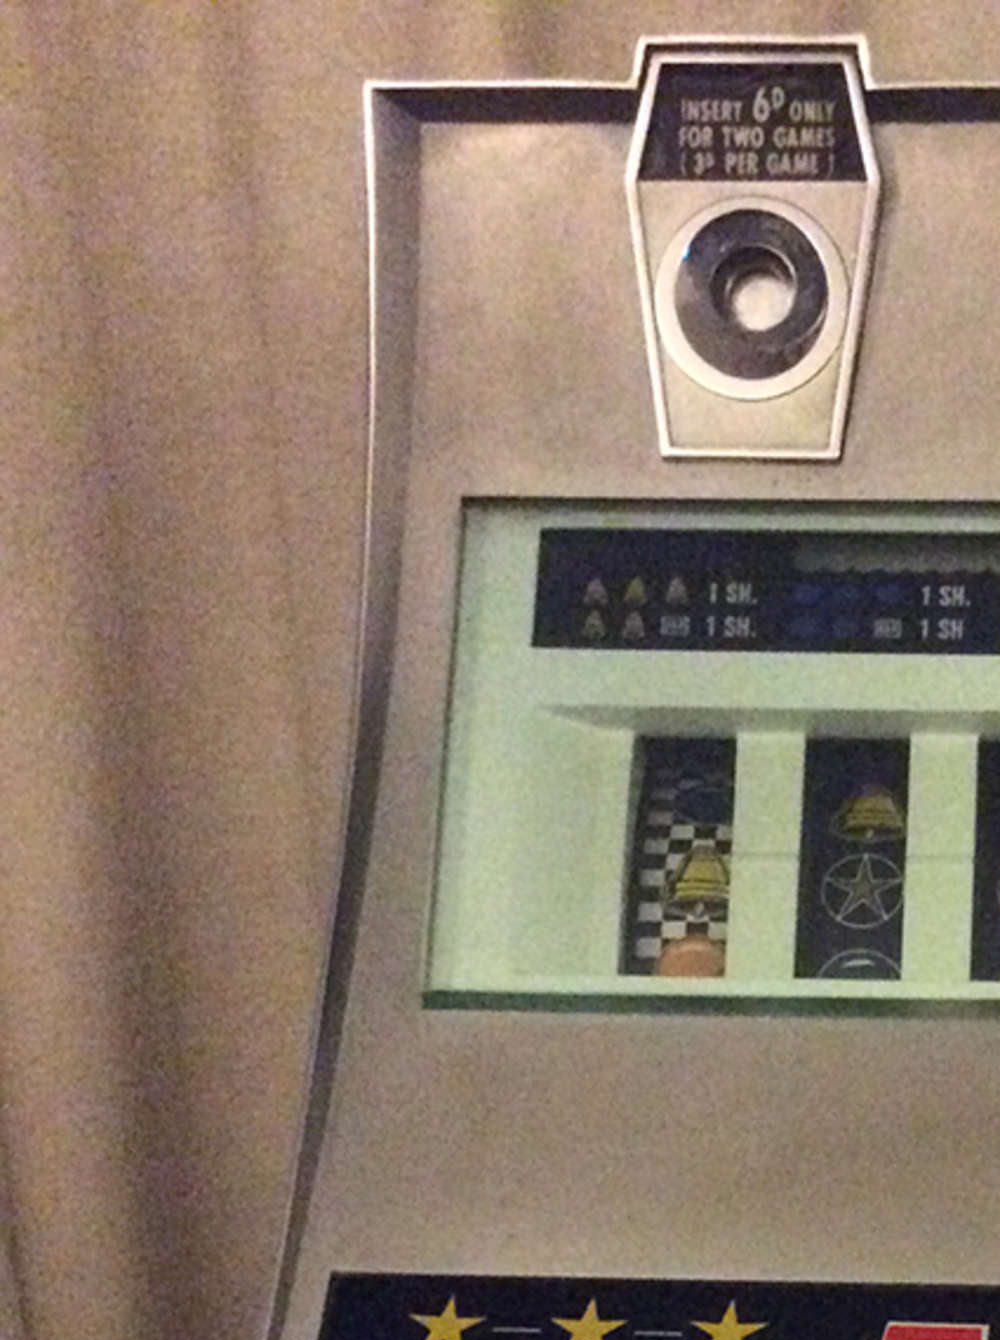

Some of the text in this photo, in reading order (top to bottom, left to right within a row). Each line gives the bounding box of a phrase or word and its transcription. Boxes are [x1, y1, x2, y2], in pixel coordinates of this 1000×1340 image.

[681, 100, 743, 122] INSERT
[789, 100, 835, 122] ONLY
[678, 126, 836, 148] FOR TWO GAMES
[725, 153, 760, 175] PER
[766, 153, 819, 176] GAME
[711, 582, 718, 603] 1
[922, 586, 930, 606] 1
[706, 616, 716, 637] 1
[921, 619, 929, 640] 1
